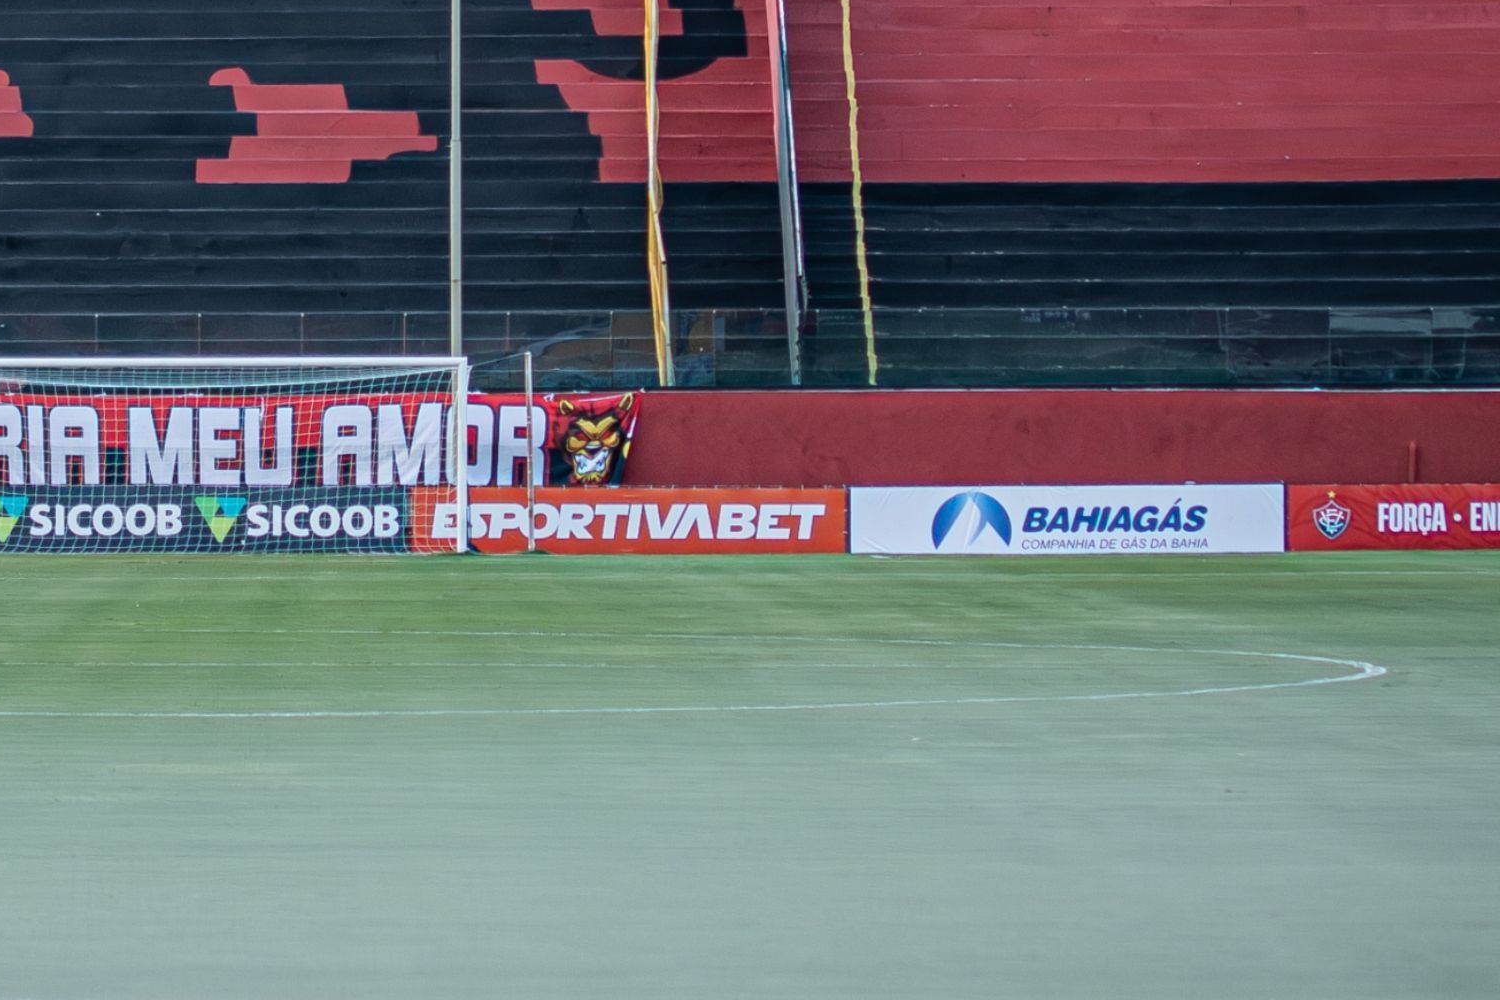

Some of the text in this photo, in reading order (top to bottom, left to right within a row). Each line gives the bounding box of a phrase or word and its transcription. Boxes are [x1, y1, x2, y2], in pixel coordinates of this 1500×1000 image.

[128, 405, 293, 486] MEU
[323, 402, 546, 487] AMOR
[29, 503, 183, 536] SICOOB
[247, 503, 400, 538] SICOOB
[431, 504, 825, 540] ESPORTIVABET
[1022, 498, 1208, 533] BAHIAGÁS
[1377, 503, 1447, 535] FORÇA
[1021, 537, 1209, 550] COMPANHIA DE GÁS DA BAHIA
